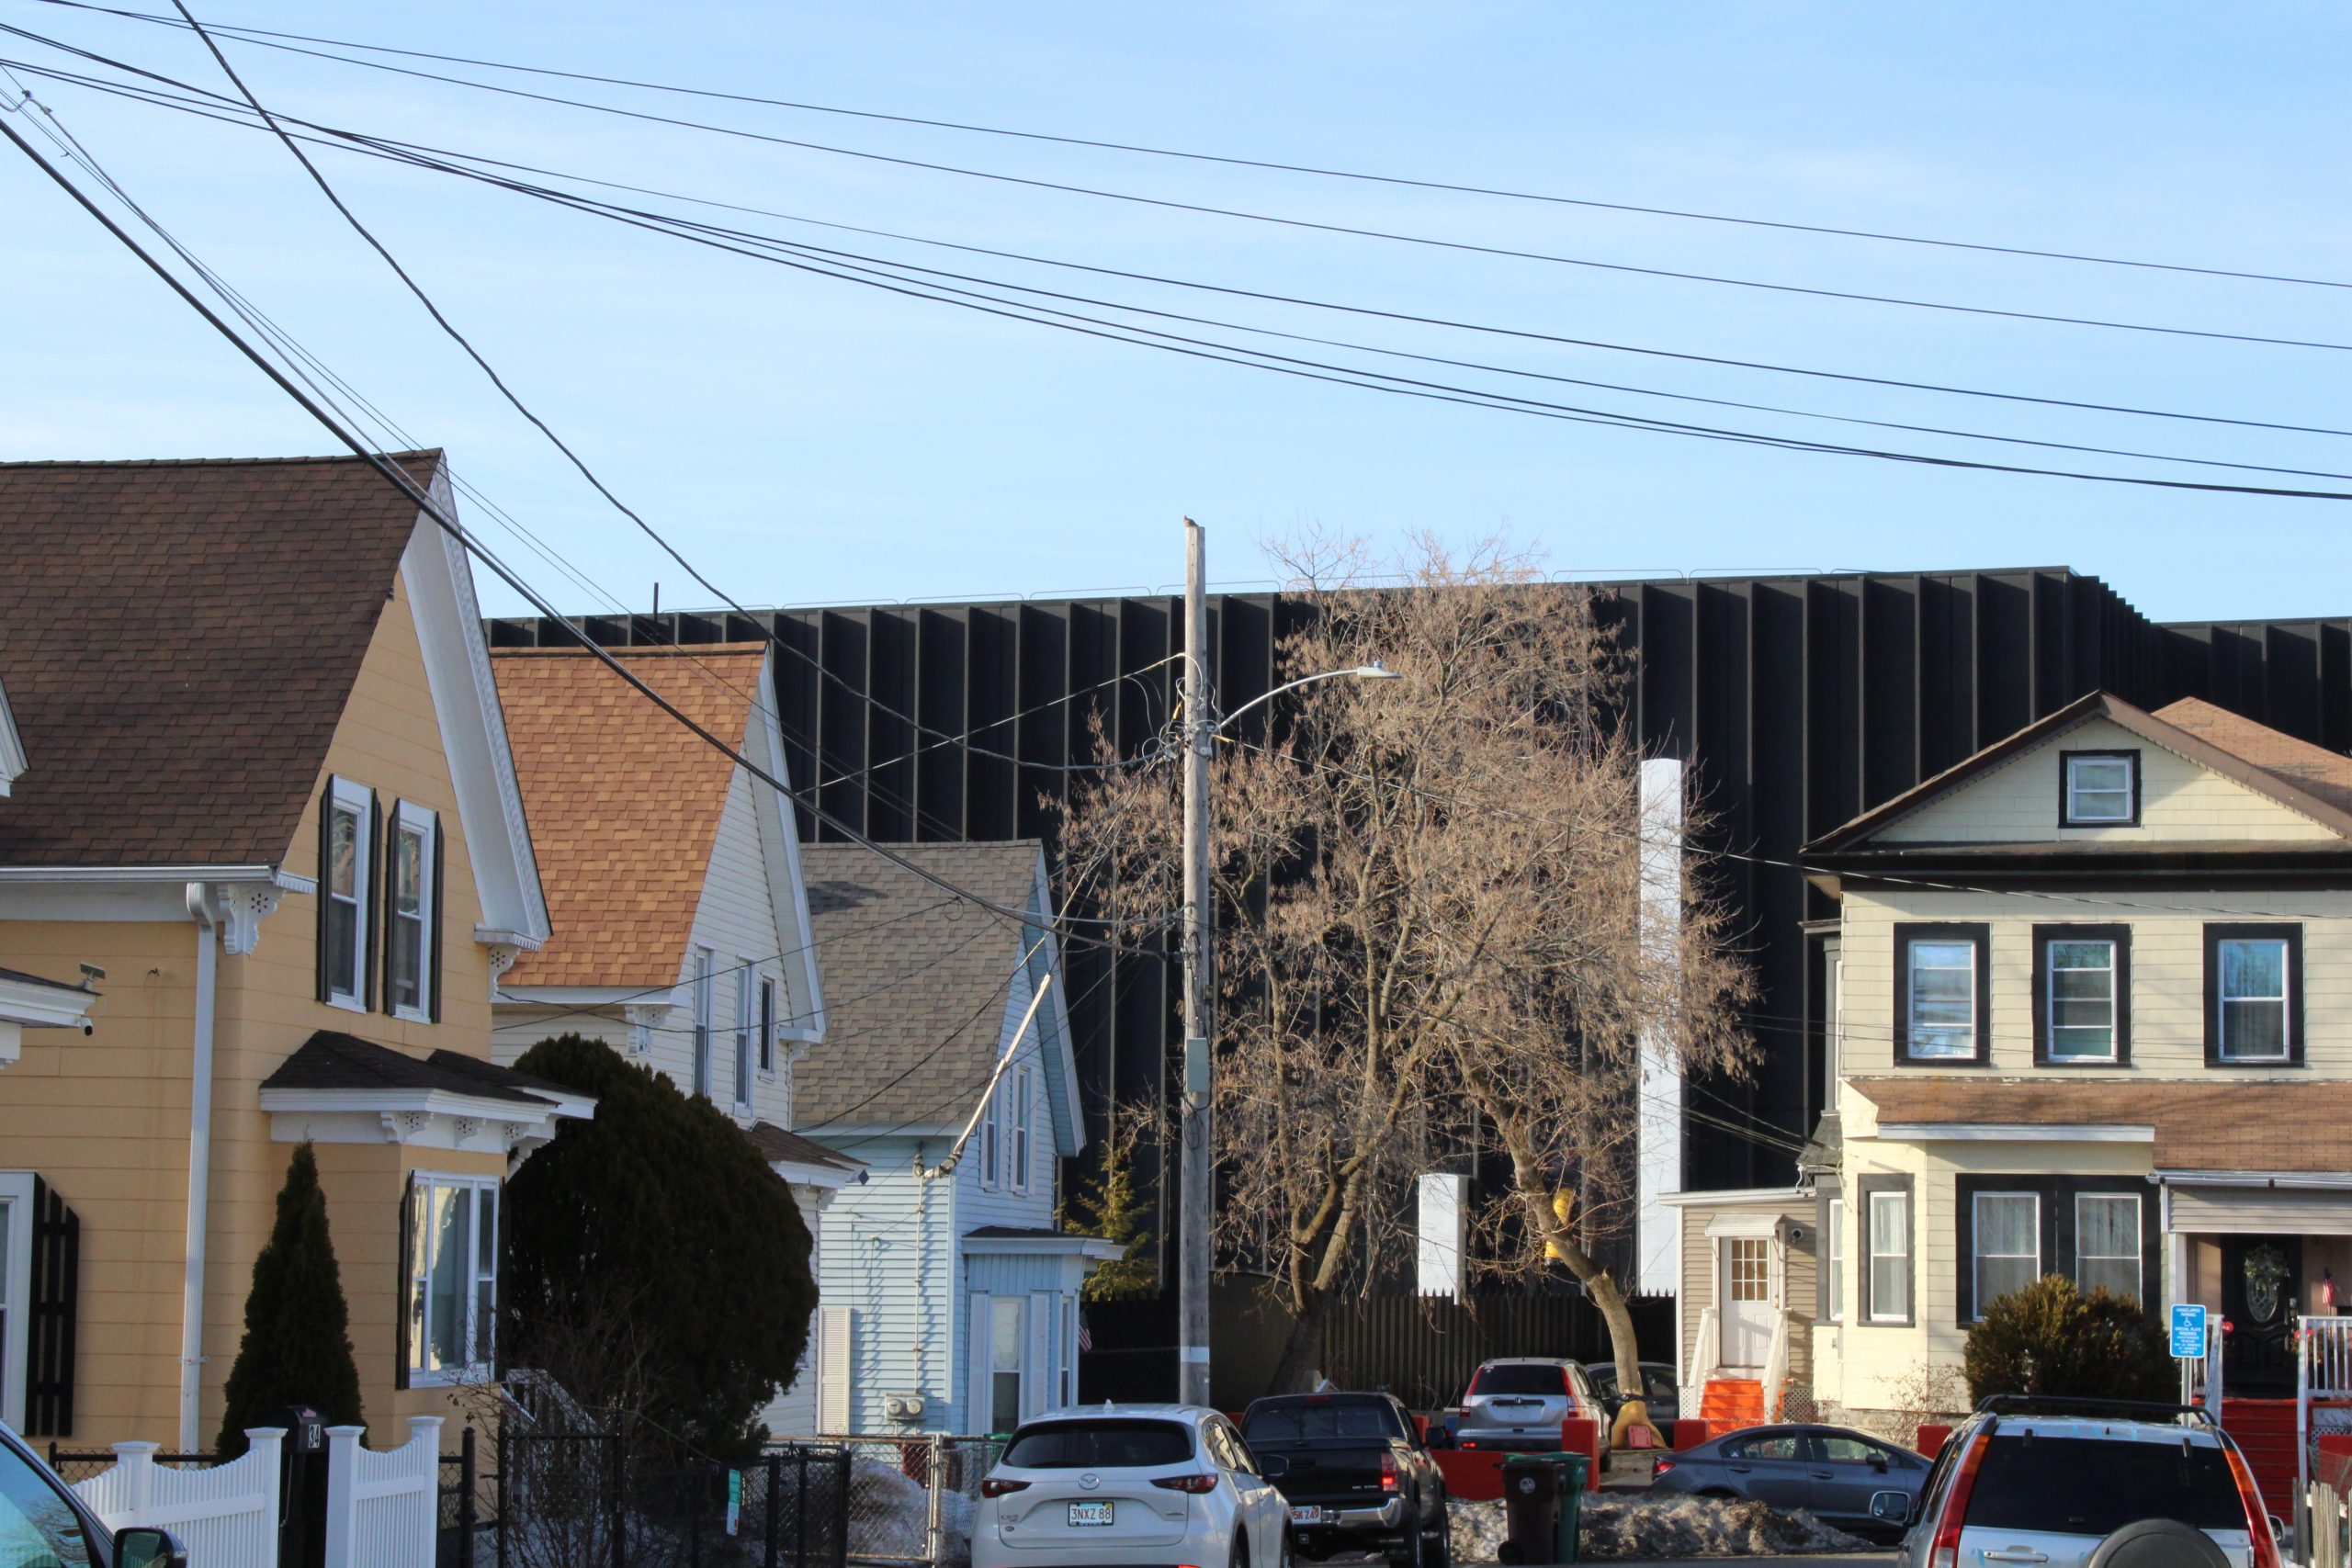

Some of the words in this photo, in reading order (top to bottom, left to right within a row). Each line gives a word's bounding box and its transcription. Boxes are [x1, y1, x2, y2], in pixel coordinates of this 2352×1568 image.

[310, 1425, 320, 1447] 34
[1071, 1508, 1097, 1520] 3NXZ
[1099, 1508, 1111, 1520] 88
